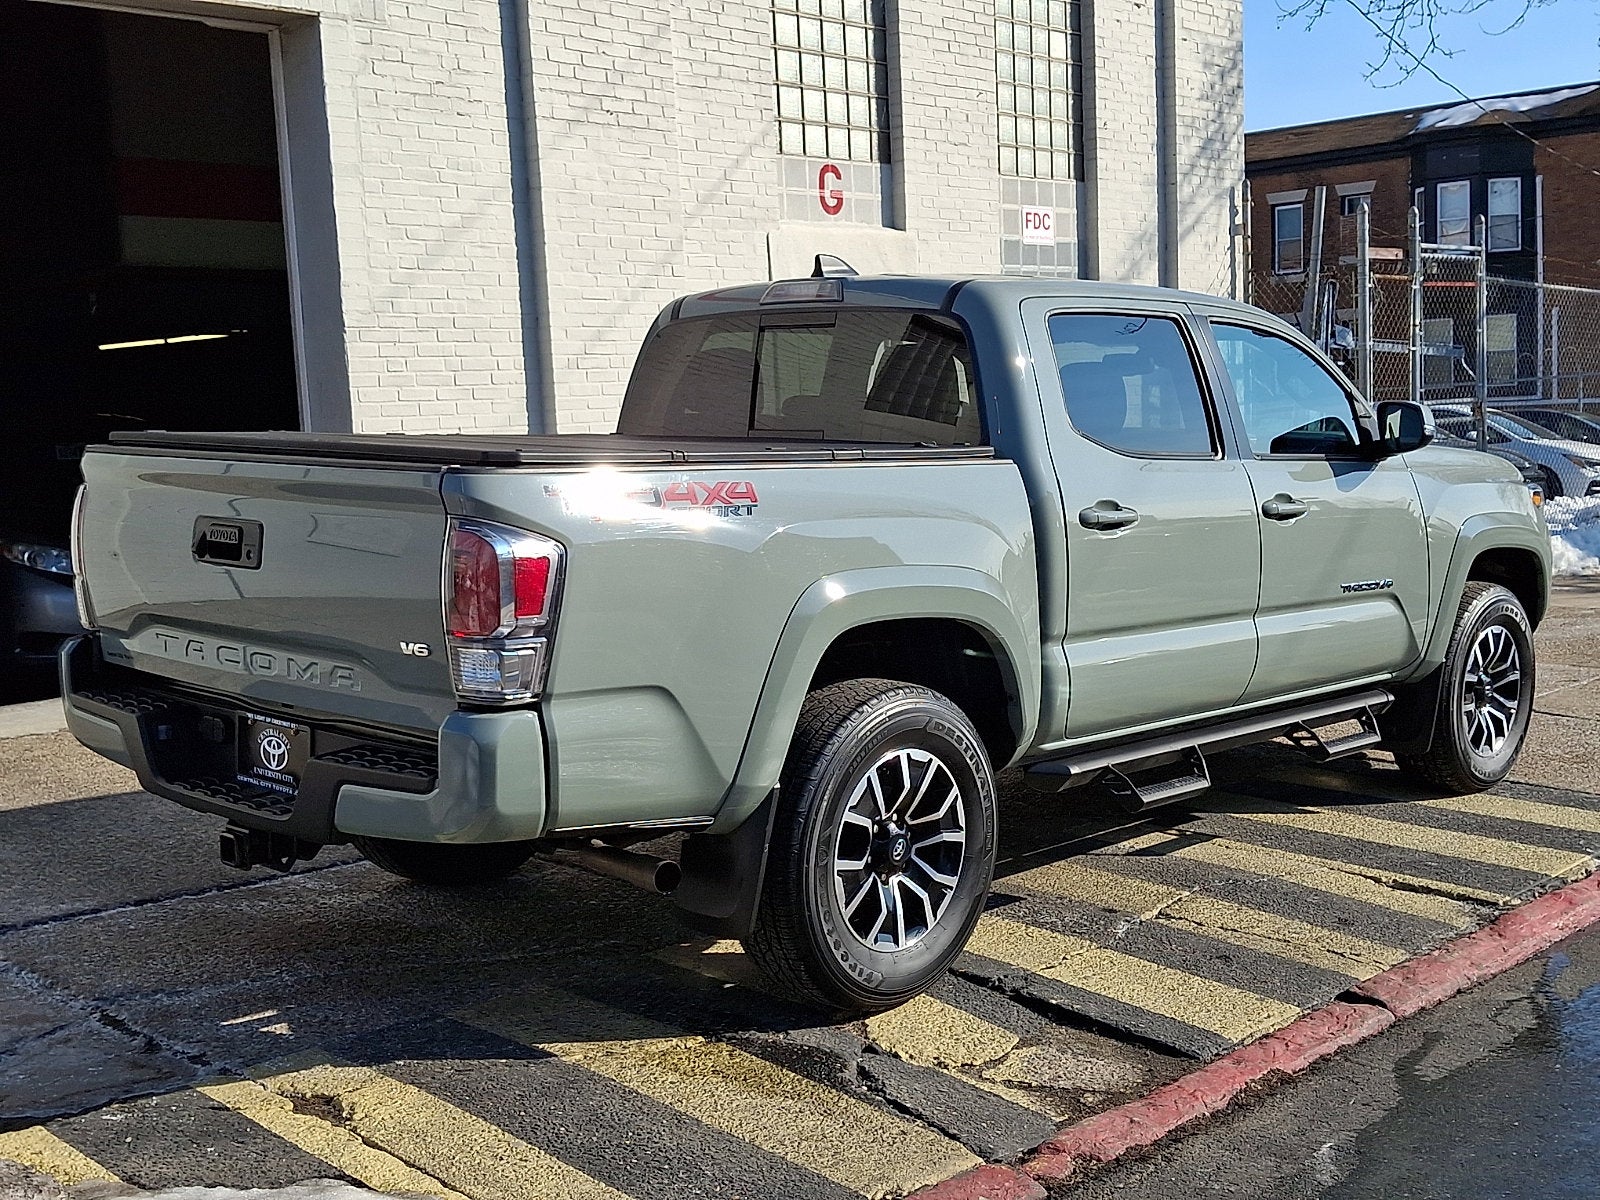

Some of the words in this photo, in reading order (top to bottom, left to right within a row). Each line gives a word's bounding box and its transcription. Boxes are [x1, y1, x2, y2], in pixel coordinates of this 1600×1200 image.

[818, 164, 844, 216] G
[1025, 212, 1051, 230] FDC
[399, 641, 431, 657] V6
[155, 632, 362, 692] TACOMA
[257, 728, 280, 744] CENTRAL
[279, 731, 292, 750] CITY
[237, 775, 259, 786] CENTRAL
[260, 781, 272, 789] CITY
[272, 784, 293, 794] TOYOTA
